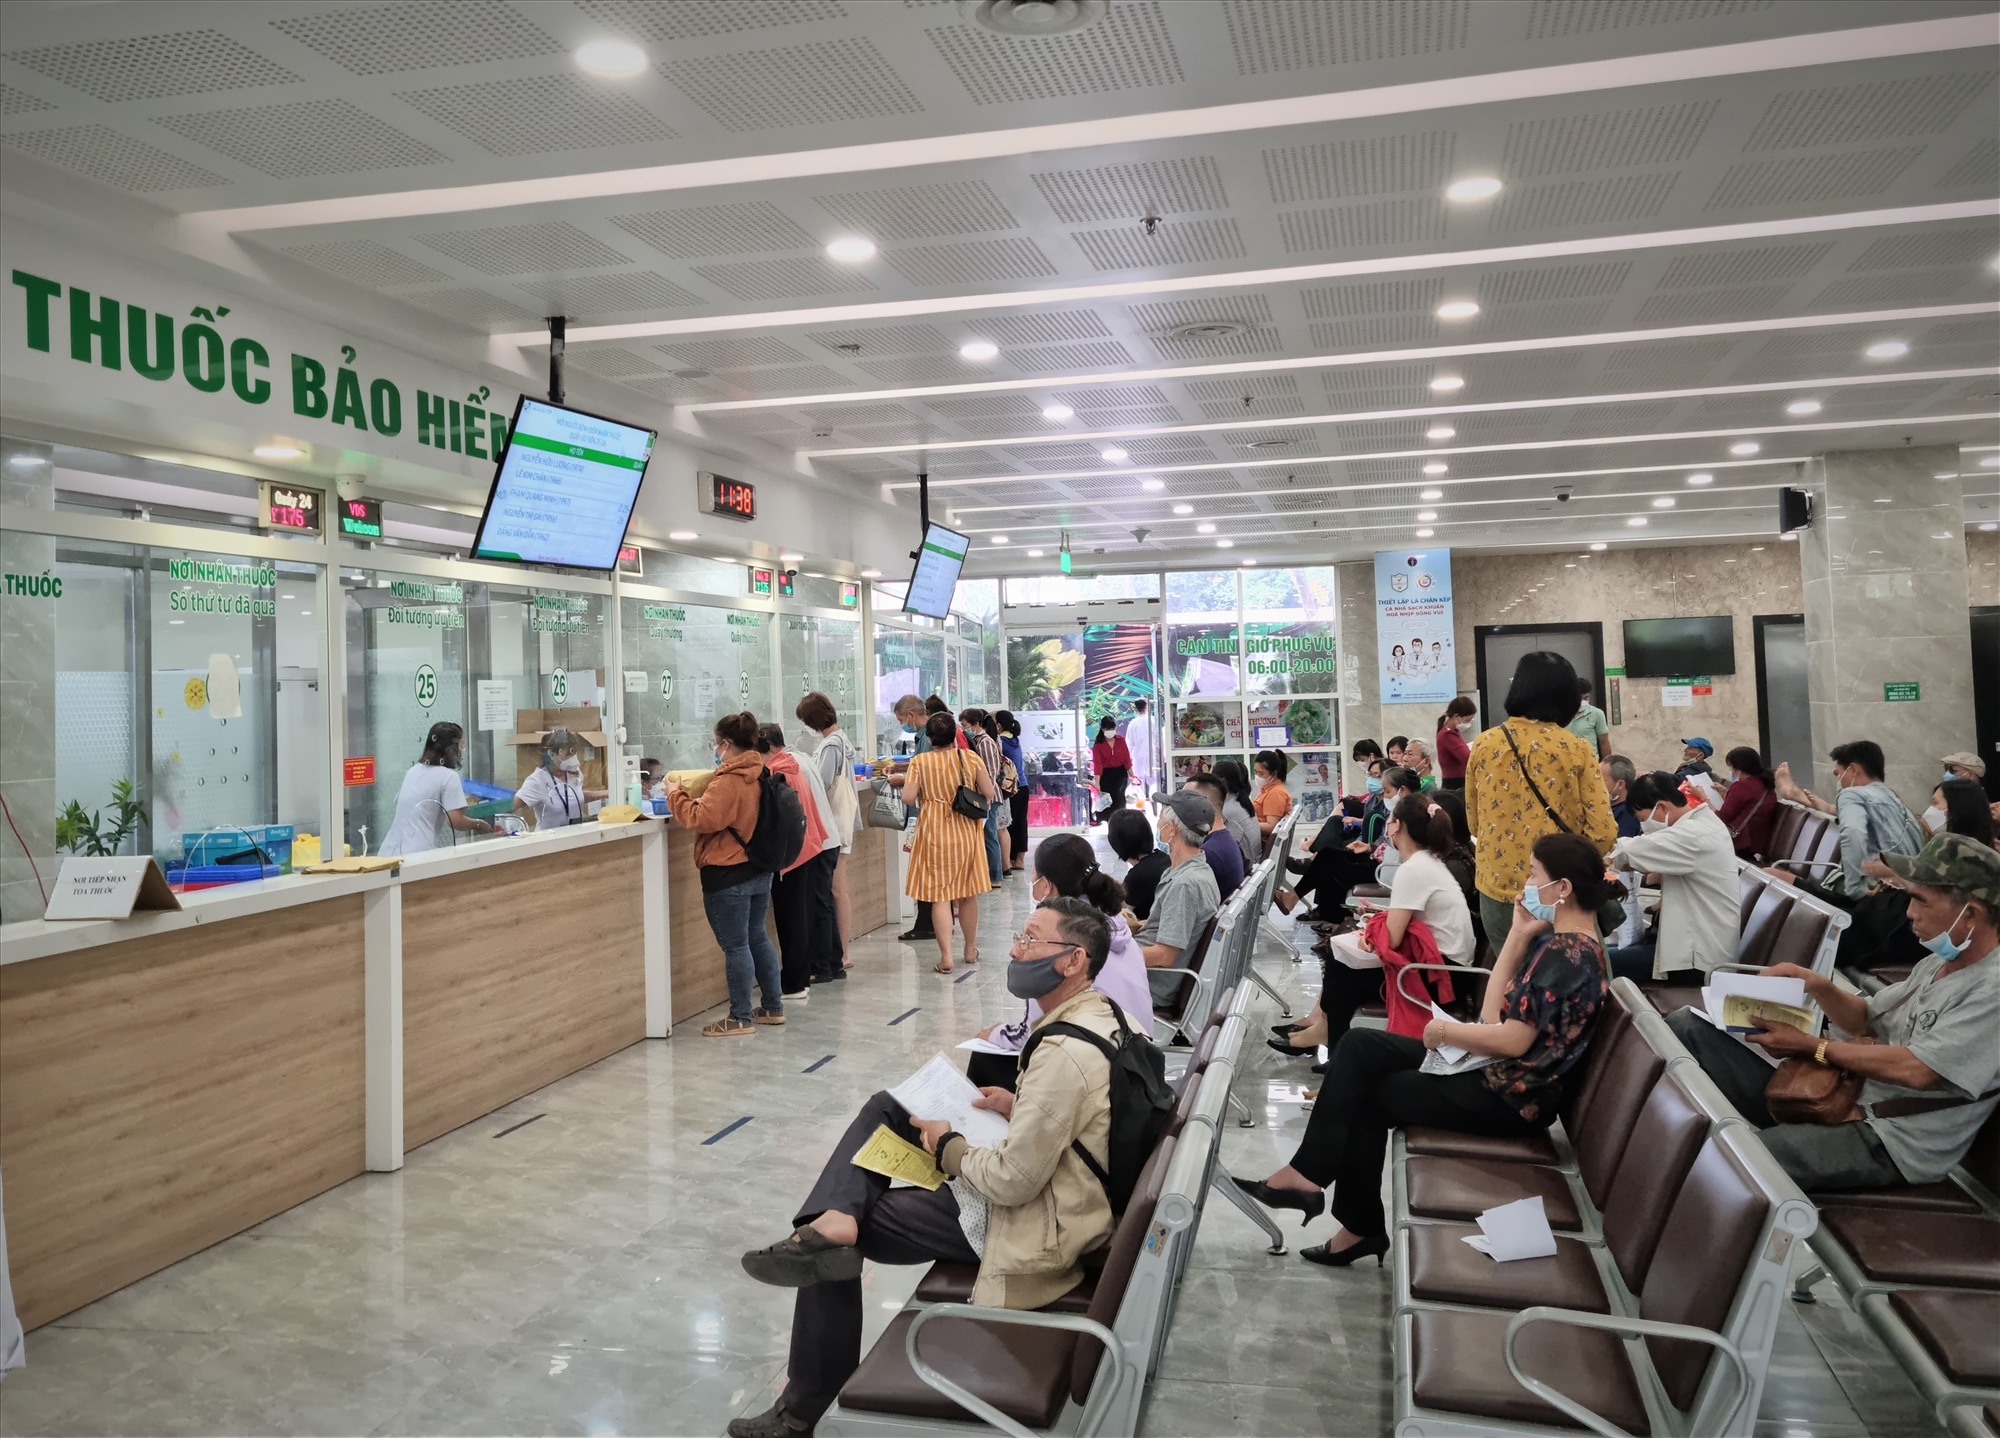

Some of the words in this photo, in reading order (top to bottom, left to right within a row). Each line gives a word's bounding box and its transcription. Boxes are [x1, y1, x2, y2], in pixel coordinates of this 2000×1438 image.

[12, 269, 271, 405] THUỐC
[291, 345, 402, 437] BẢO
[299, 493, 312, 510] 24
[721, 483, 752, 513] 11:38
[4, 569, 63, 598] THUỐC
[170, 557, 194, 580] NƠI
[196, 559, 233, 588] NHẬN
[235, 562, 277, 587] THUỐC
[408, 580, 433, 604] NHẬN
[170, 590, 188, 611] Số
[190, 589, 214, 613] thứ
[217, 595, 232, 619] tự
[235, 594, 250, 615] đã
[253, 600, 276, 620] qua
[405, 608, 433, 630] tượng
[1177, 636, 1208, 655] CĂN
[1213, 639, 1237, 653] TIN
[1246, 636, 1269, 654] GIỜ
[1271, 636, 1311, 656] PHỤC
[1312, 635, 1335, 655] VỤ
[1248, 658, 1334, 674] 06:00-20:00
[418, 674, 435, 699] 25
[553, 674, 566, 697] 26
[662, 675, 671, 694] 27
[741, 676, 749, 693] 28
